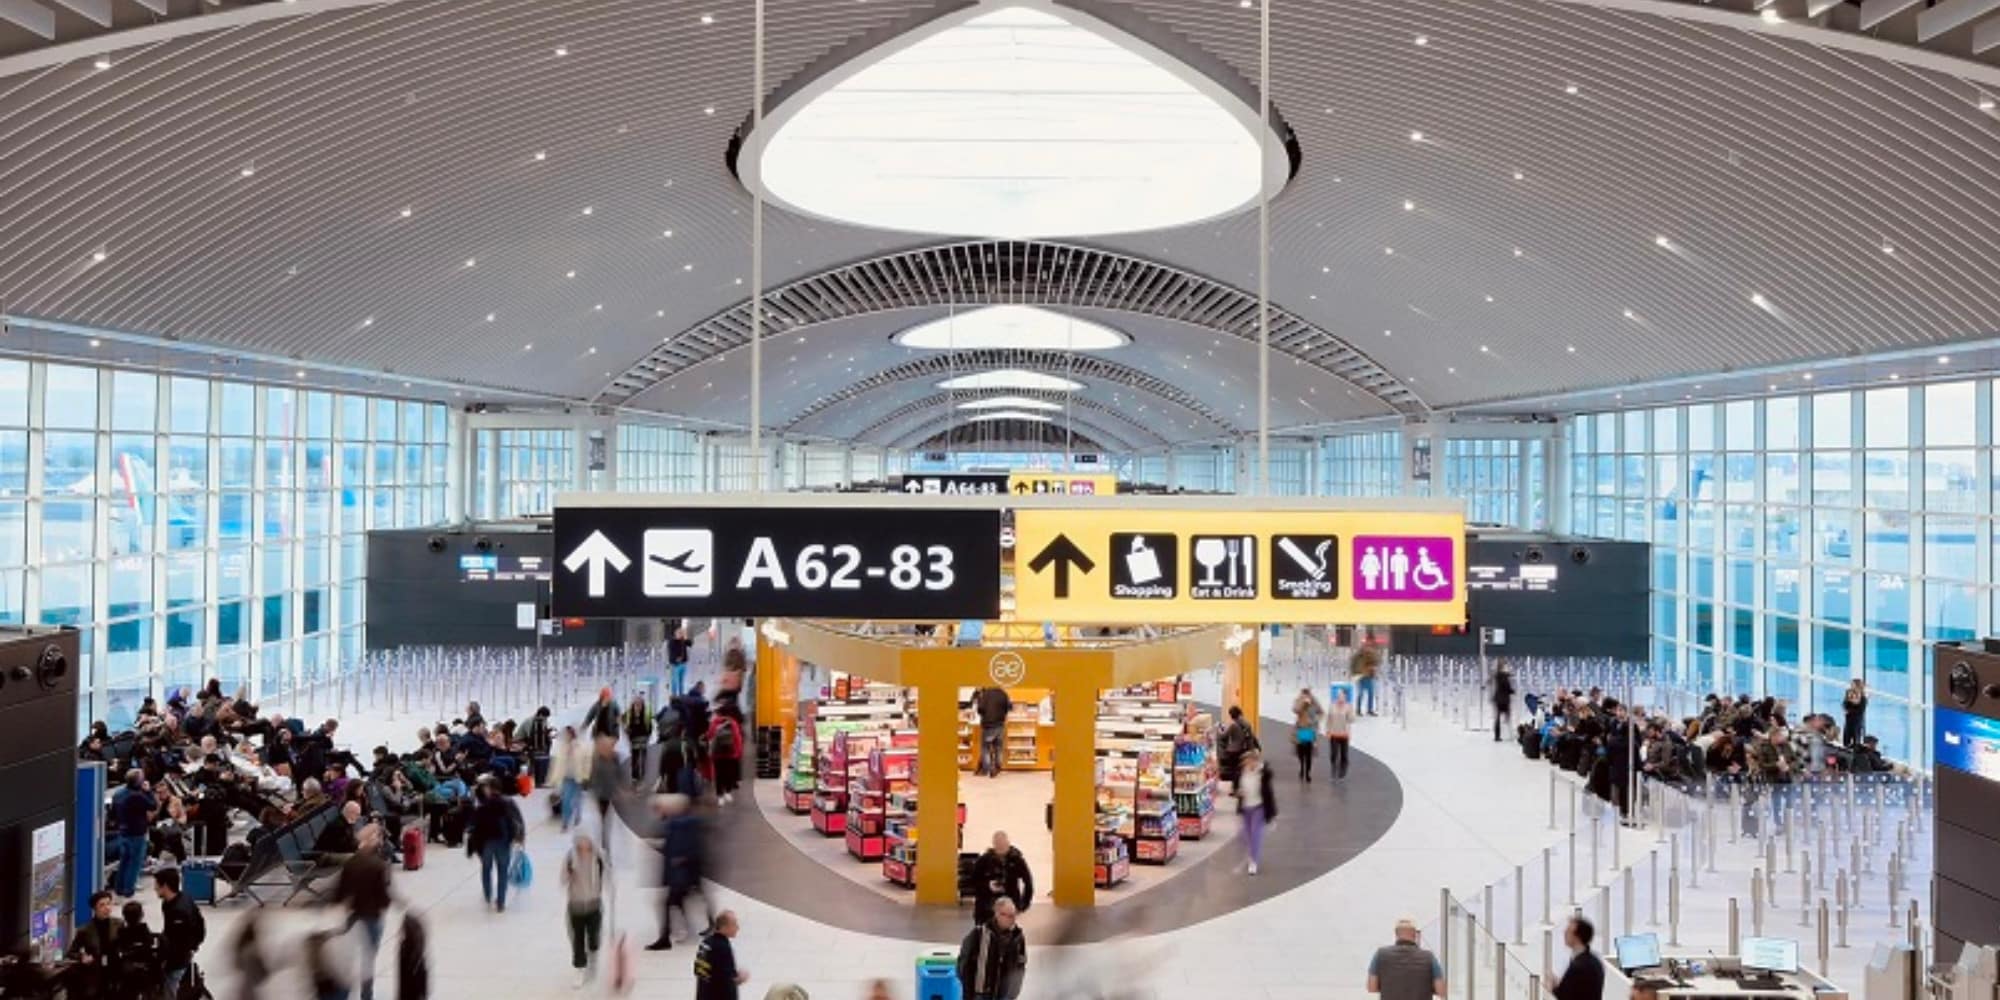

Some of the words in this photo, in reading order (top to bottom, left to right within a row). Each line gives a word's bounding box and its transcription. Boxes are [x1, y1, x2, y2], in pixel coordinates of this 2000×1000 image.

[1114, 584, 1172, 598] Shopping
[1191, 587, 1210, 597] Eat
[1211, 587, 1222, 597] &
[1223, 586, 1255, 597] Drink
[1277, 578, 1332, 592] Smoking
